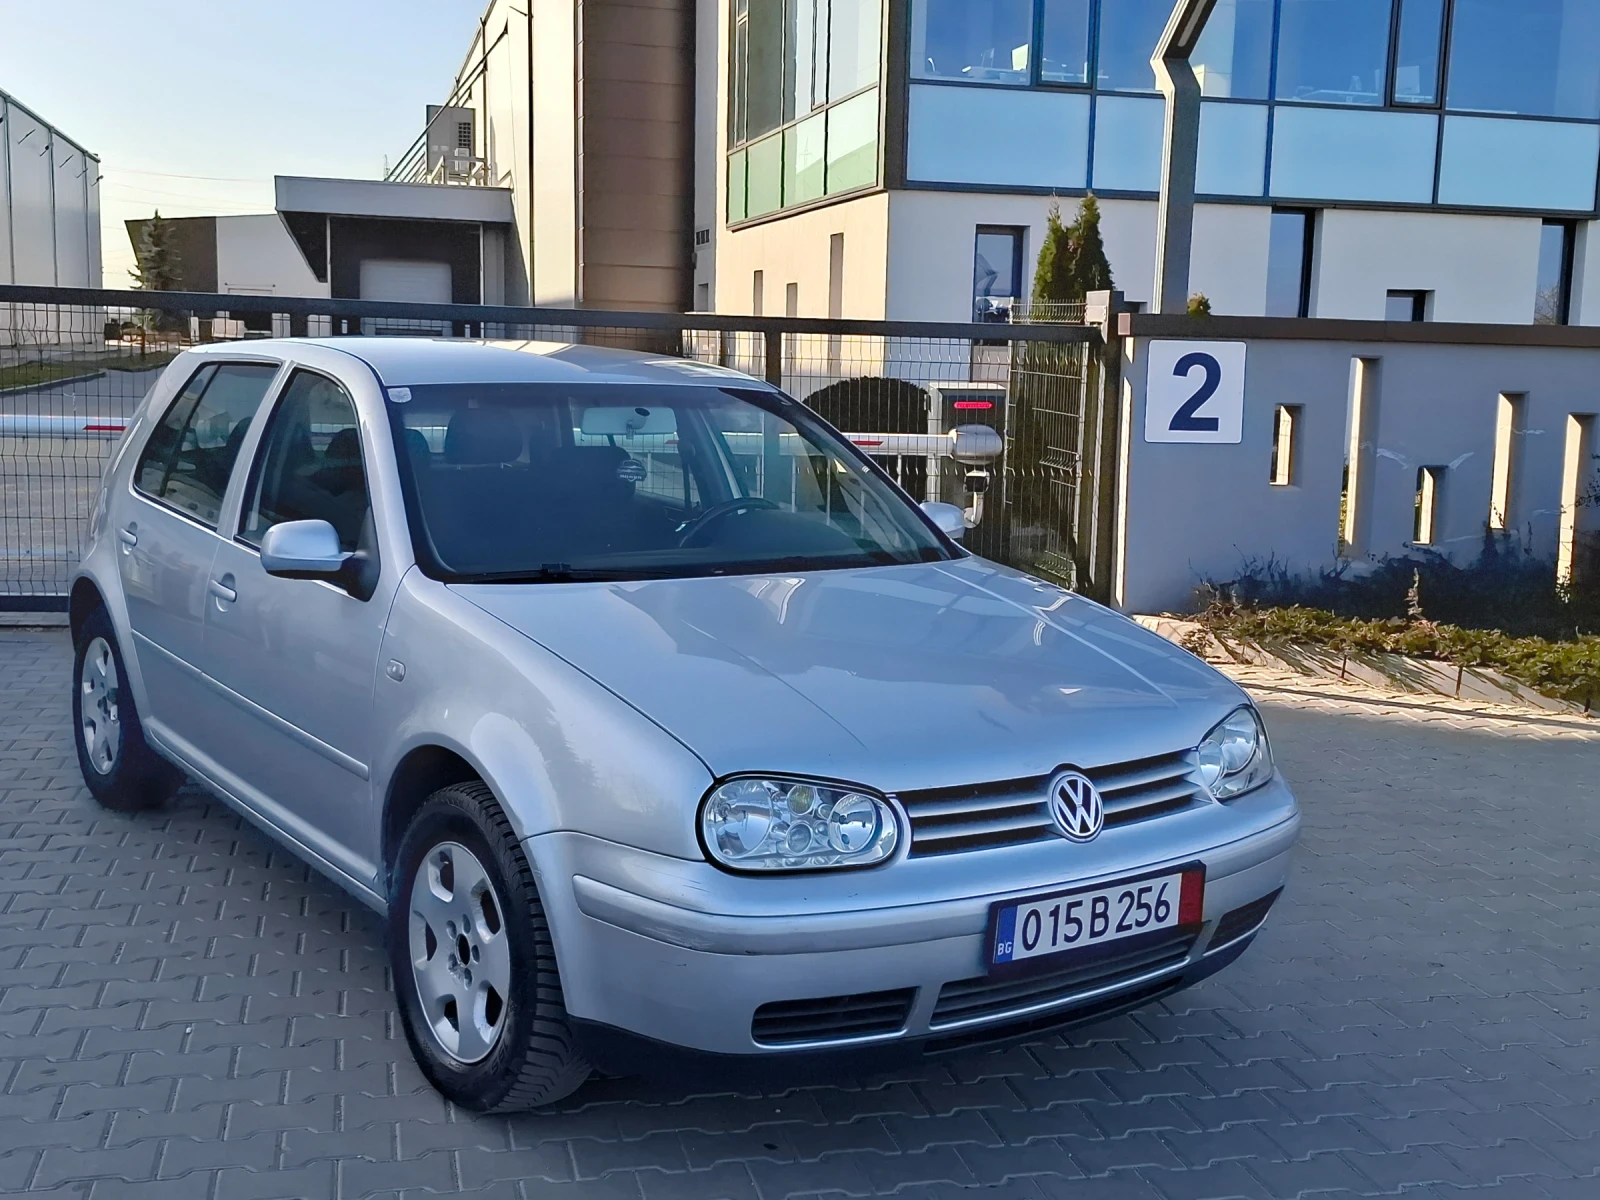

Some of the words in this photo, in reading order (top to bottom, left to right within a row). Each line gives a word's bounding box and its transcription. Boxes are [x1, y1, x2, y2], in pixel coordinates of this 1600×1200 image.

[1168, 352, 1222, 432] 2
[1053, 776, 1100, 836] VW
[997, 941, 1013, 956] BG
